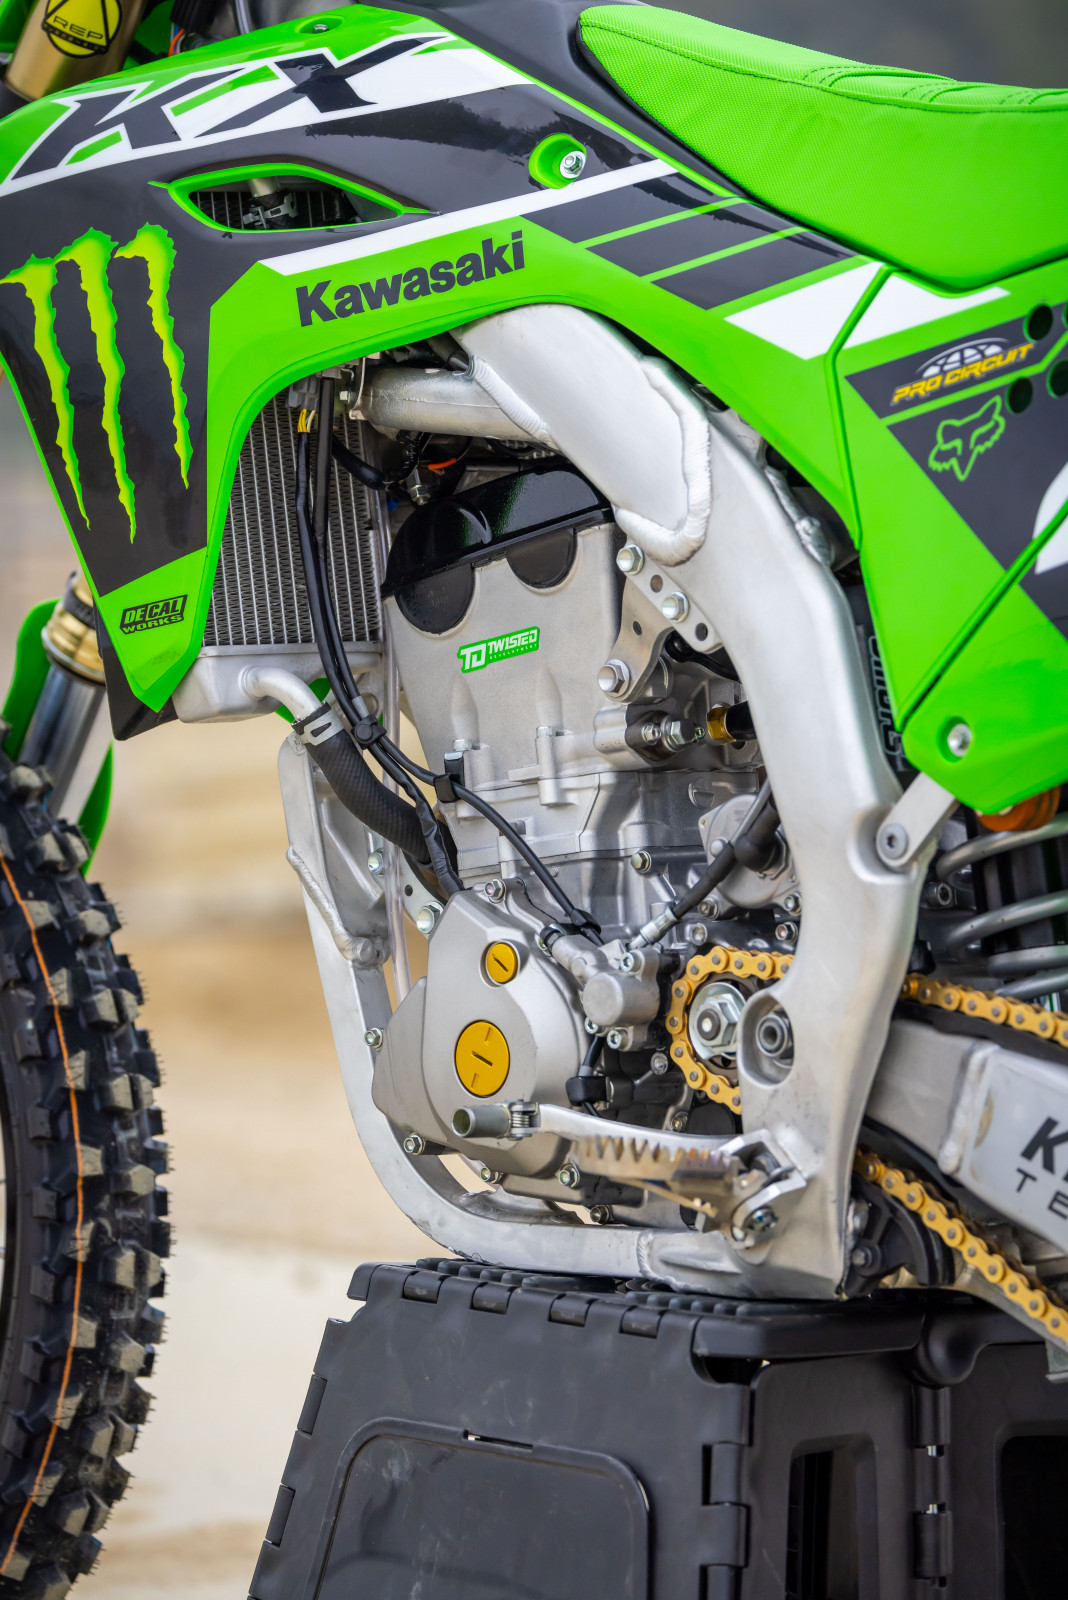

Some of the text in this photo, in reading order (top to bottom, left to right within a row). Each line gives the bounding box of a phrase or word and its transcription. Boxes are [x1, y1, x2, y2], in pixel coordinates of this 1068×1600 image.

[53, 16, 103, 40] REP
[11, 36, 448, 180] KX
[296, 230, 525, 327] Kawasaki
[892, 342, 1034, 404] PRO CIRCUIT
[122, 614, 184, 634] WORKS
[123, 599, 182, 625] DECAL
[487, 629, 538, 655] TWISTED
